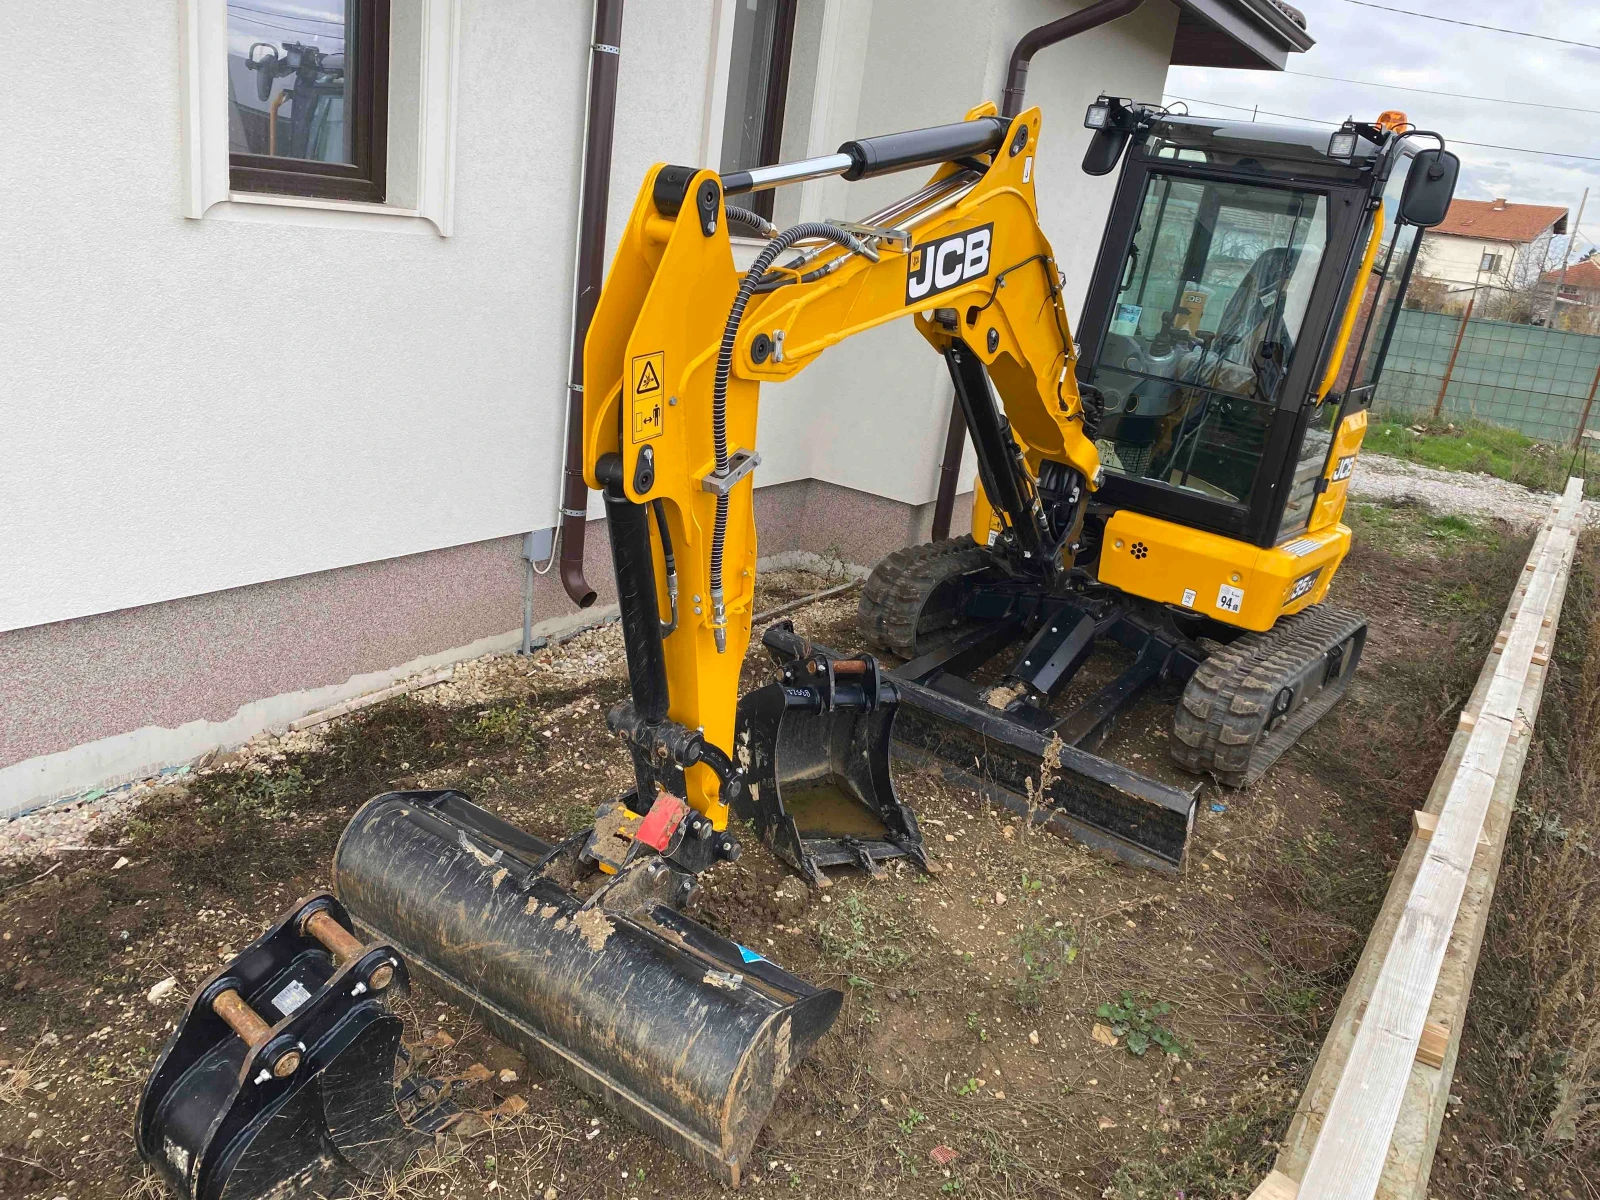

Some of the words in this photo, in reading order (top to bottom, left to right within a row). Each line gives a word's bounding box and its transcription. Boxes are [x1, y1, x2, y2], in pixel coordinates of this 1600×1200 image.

[908, 229, 991, 298] JCB
[1333, 456, 1355, 480] JCB
[1221, 595, 1233, 610] 94
